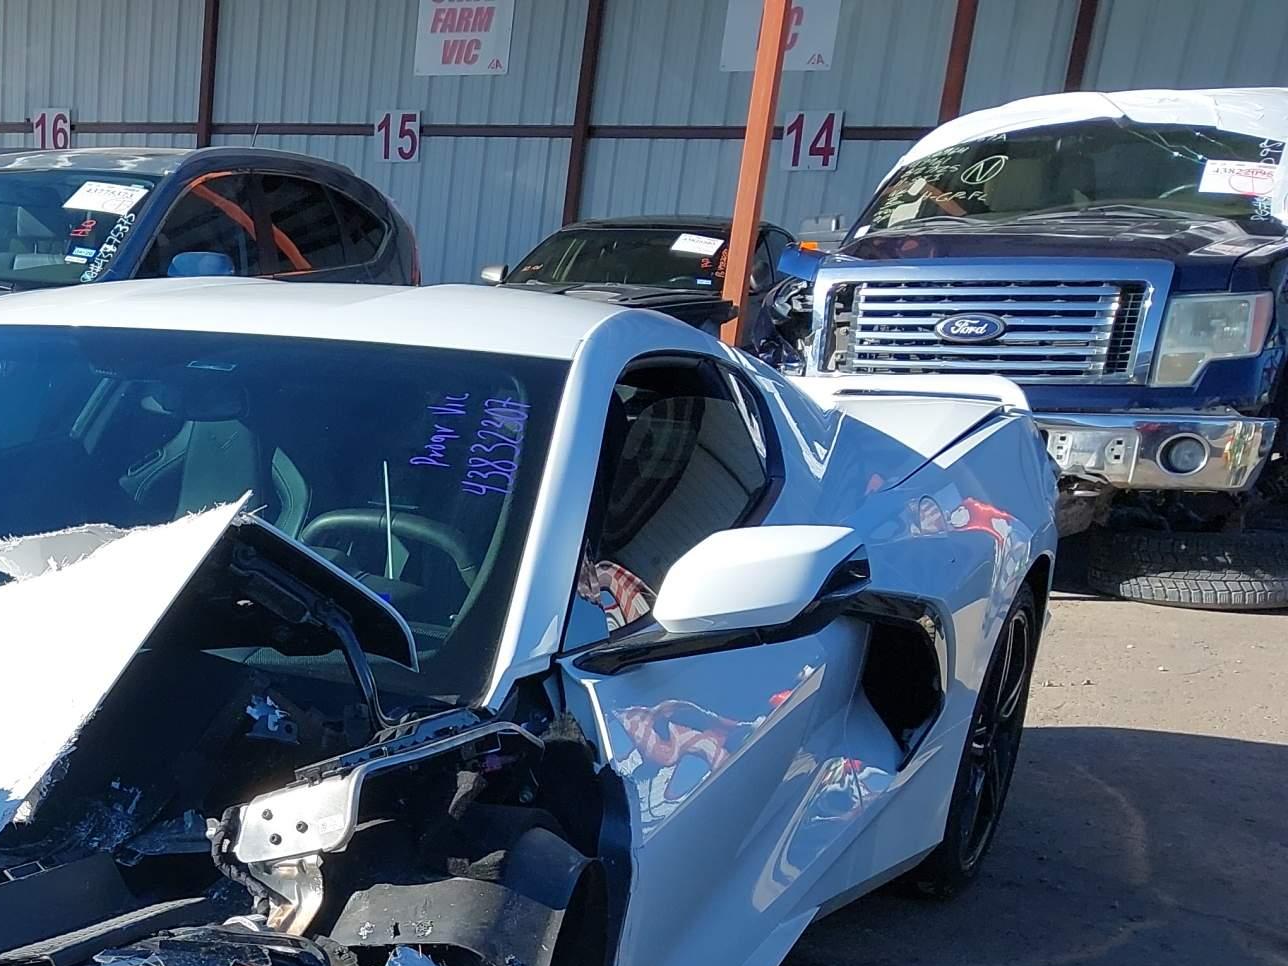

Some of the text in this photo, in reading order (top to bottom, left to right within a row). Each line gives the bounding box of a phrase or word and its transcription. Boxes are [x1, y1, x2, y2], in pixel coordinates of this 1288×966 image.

[430, 6, 496, 33] FARM
[441, 38, 481, 65] VIC
[35, 112, 69, 150] 16
[377, 112, 418, 160] 15
[786, 112, 836, 167] 14
[950, 319, 988, 335] Ford
